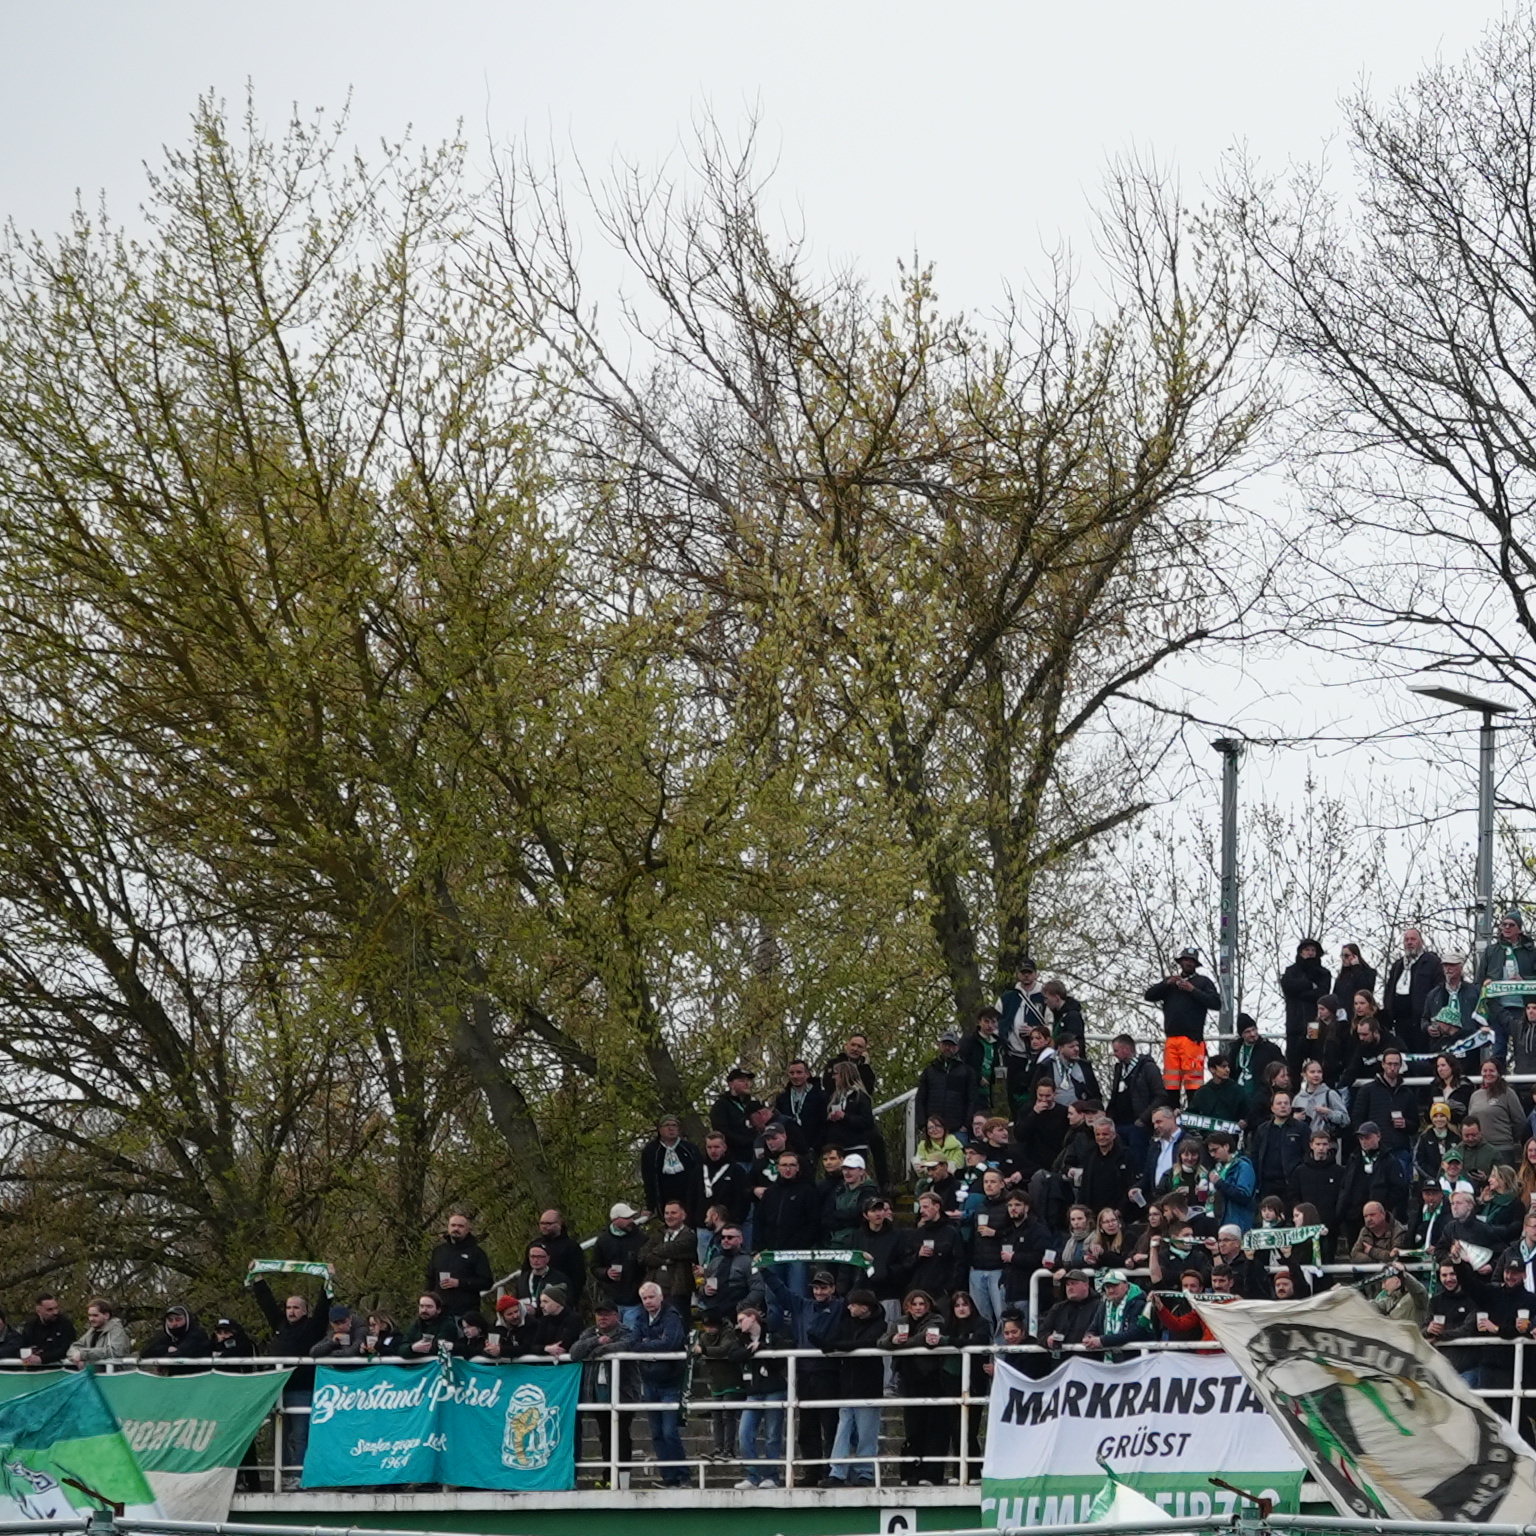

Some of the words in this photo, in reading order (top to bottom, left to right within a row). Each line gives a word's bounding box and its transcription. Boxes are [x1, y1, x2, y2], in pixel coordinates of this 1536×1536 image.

[312, 1377, 427, 1424] Bierstand
[1098, 1427, 1190, 1459] GRÜSST
[380, 1453, 411, 1469] 1964
